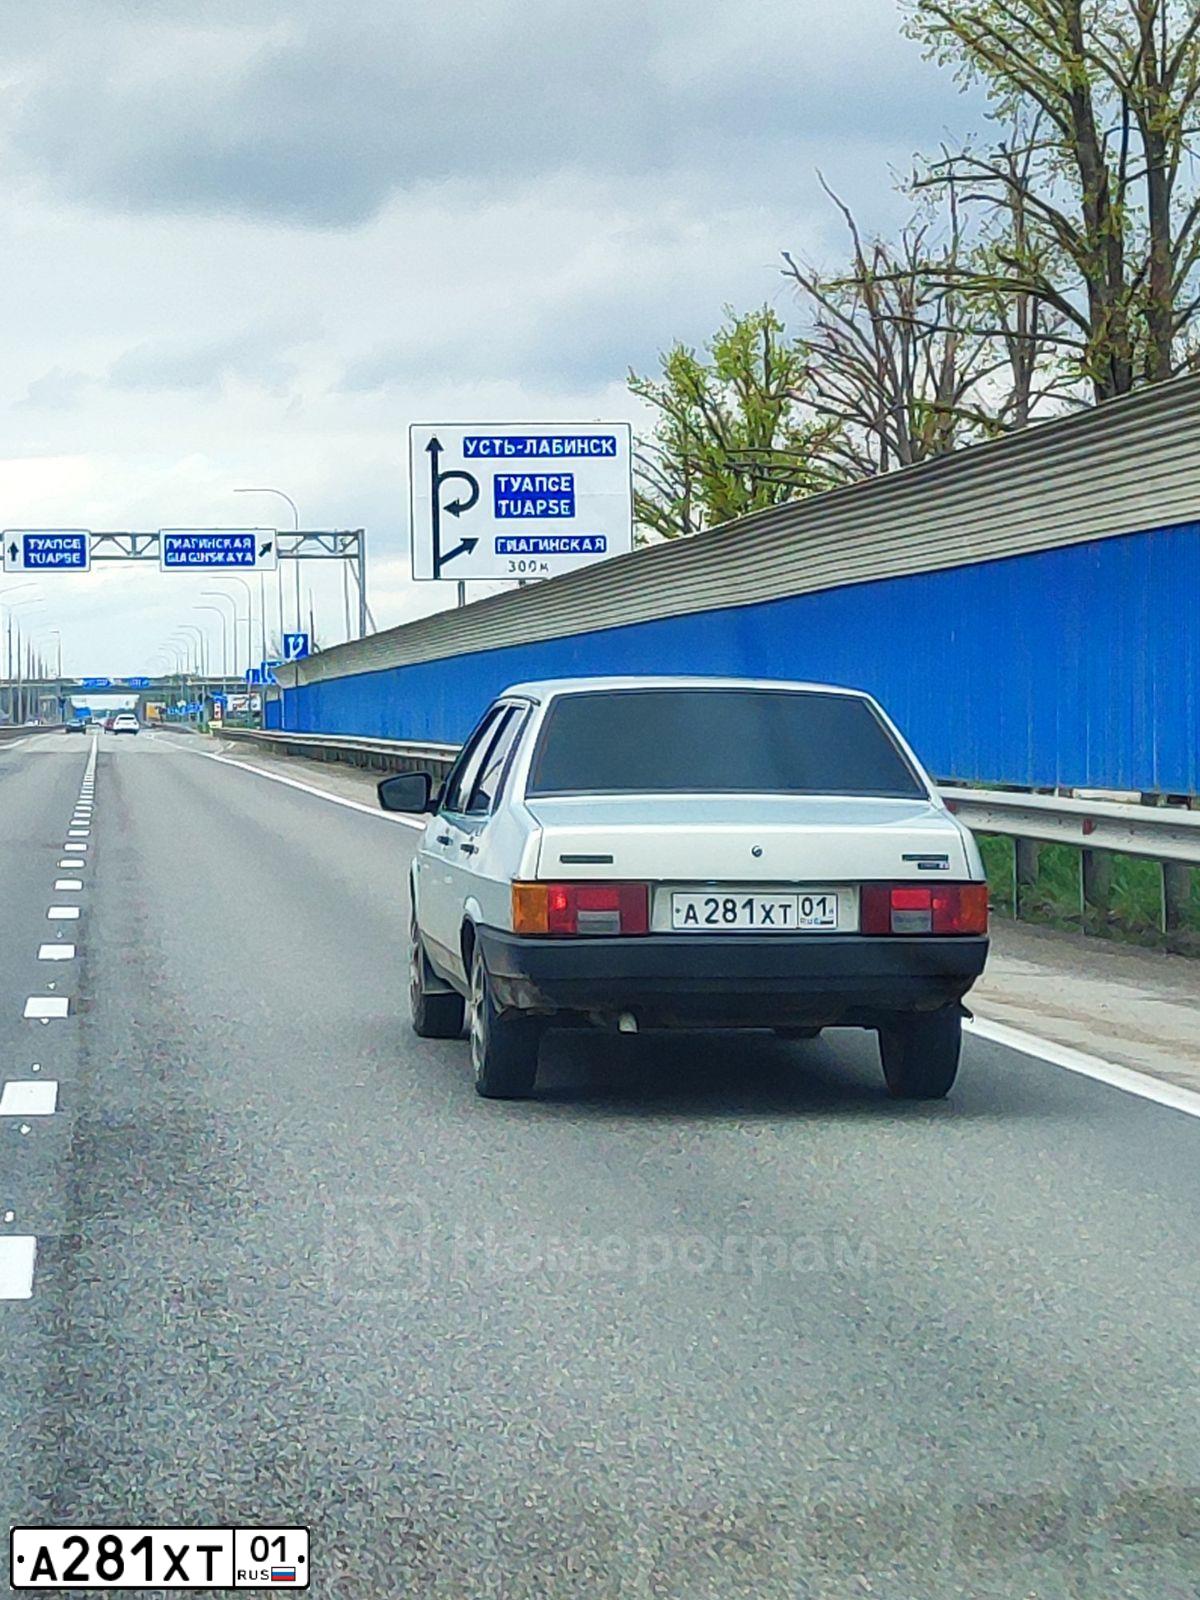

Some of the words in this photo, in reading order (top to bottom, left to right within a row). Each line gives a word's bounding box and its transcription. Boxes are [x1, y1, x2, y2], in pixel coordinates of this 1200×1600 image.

[465, 439, 615, 456] УСТЬ-ЛАБИНСК
[497, 476, 572, 493] ТУАПСЕ
[498, 499, 571, 516] TUAPSE
[28, 538, 82, 550] ТУАПСЕ
[497, 537, 606, 553] ГИАГИНСКАЯ
[28, 552, 81, 564] TUAPSE
[508, 560, 537, 573] 300
[683, 898, 792, 925] А281ХТ
[801, 897, 827, 917] 01
